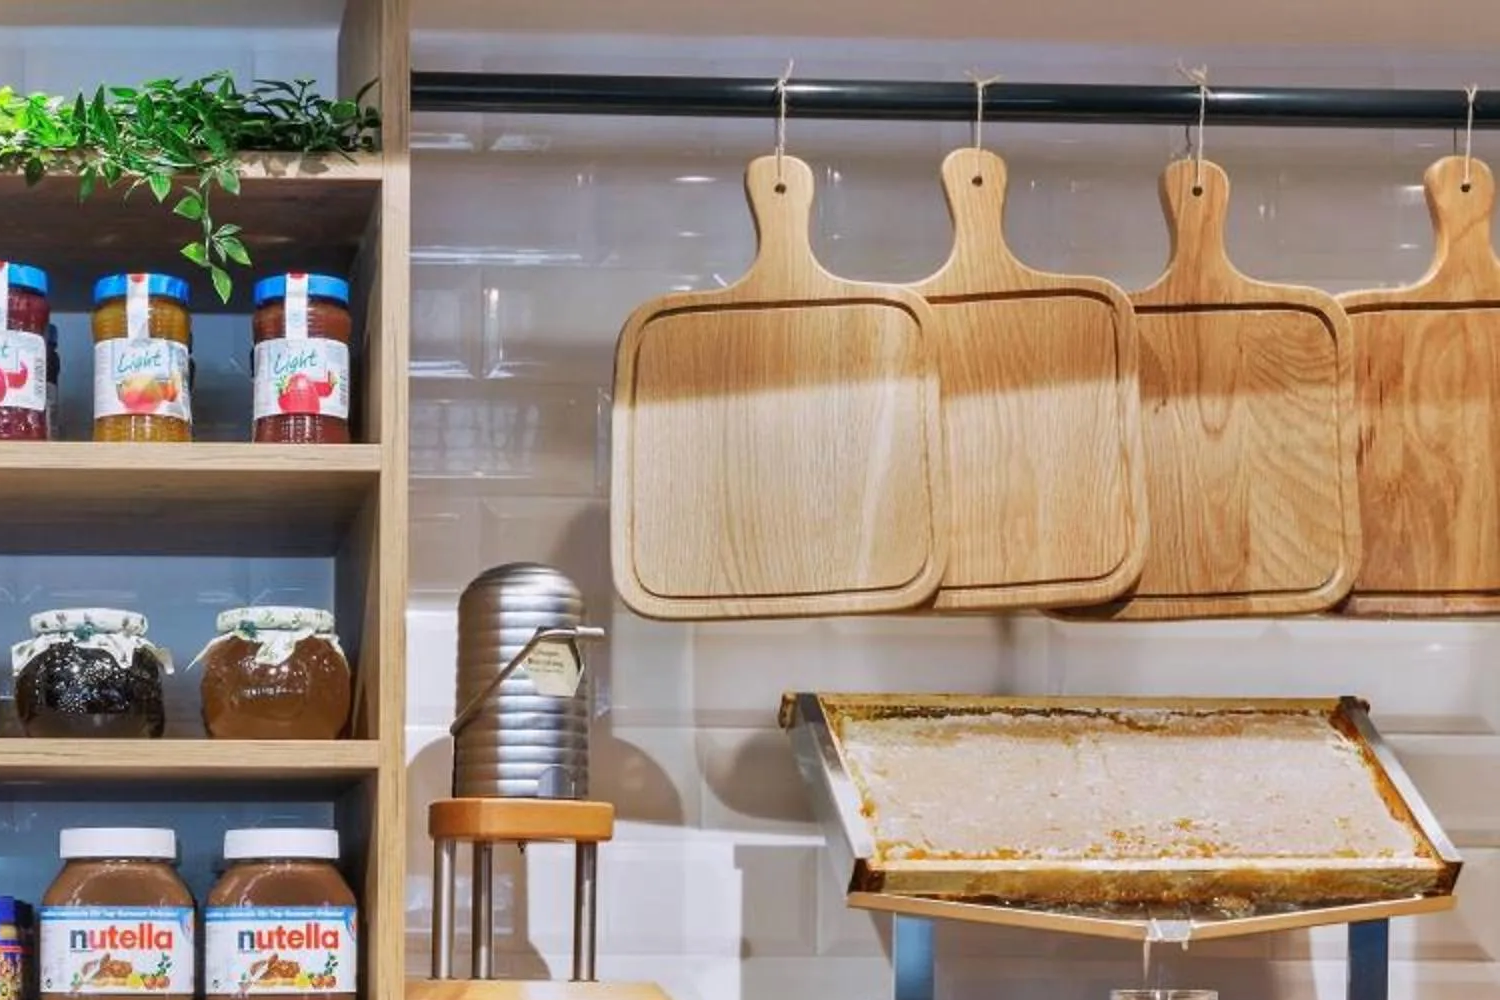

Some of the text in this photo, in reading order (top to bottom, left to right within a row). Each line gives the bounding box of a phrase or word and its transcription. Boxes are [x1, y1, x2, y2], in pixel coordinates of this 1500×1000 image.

[117, 350, 161, 374] Light
[274, 348, 317, 374] Light
[70, 923, 173, 950] nutella
[238, 923, 340, 950] nutella
